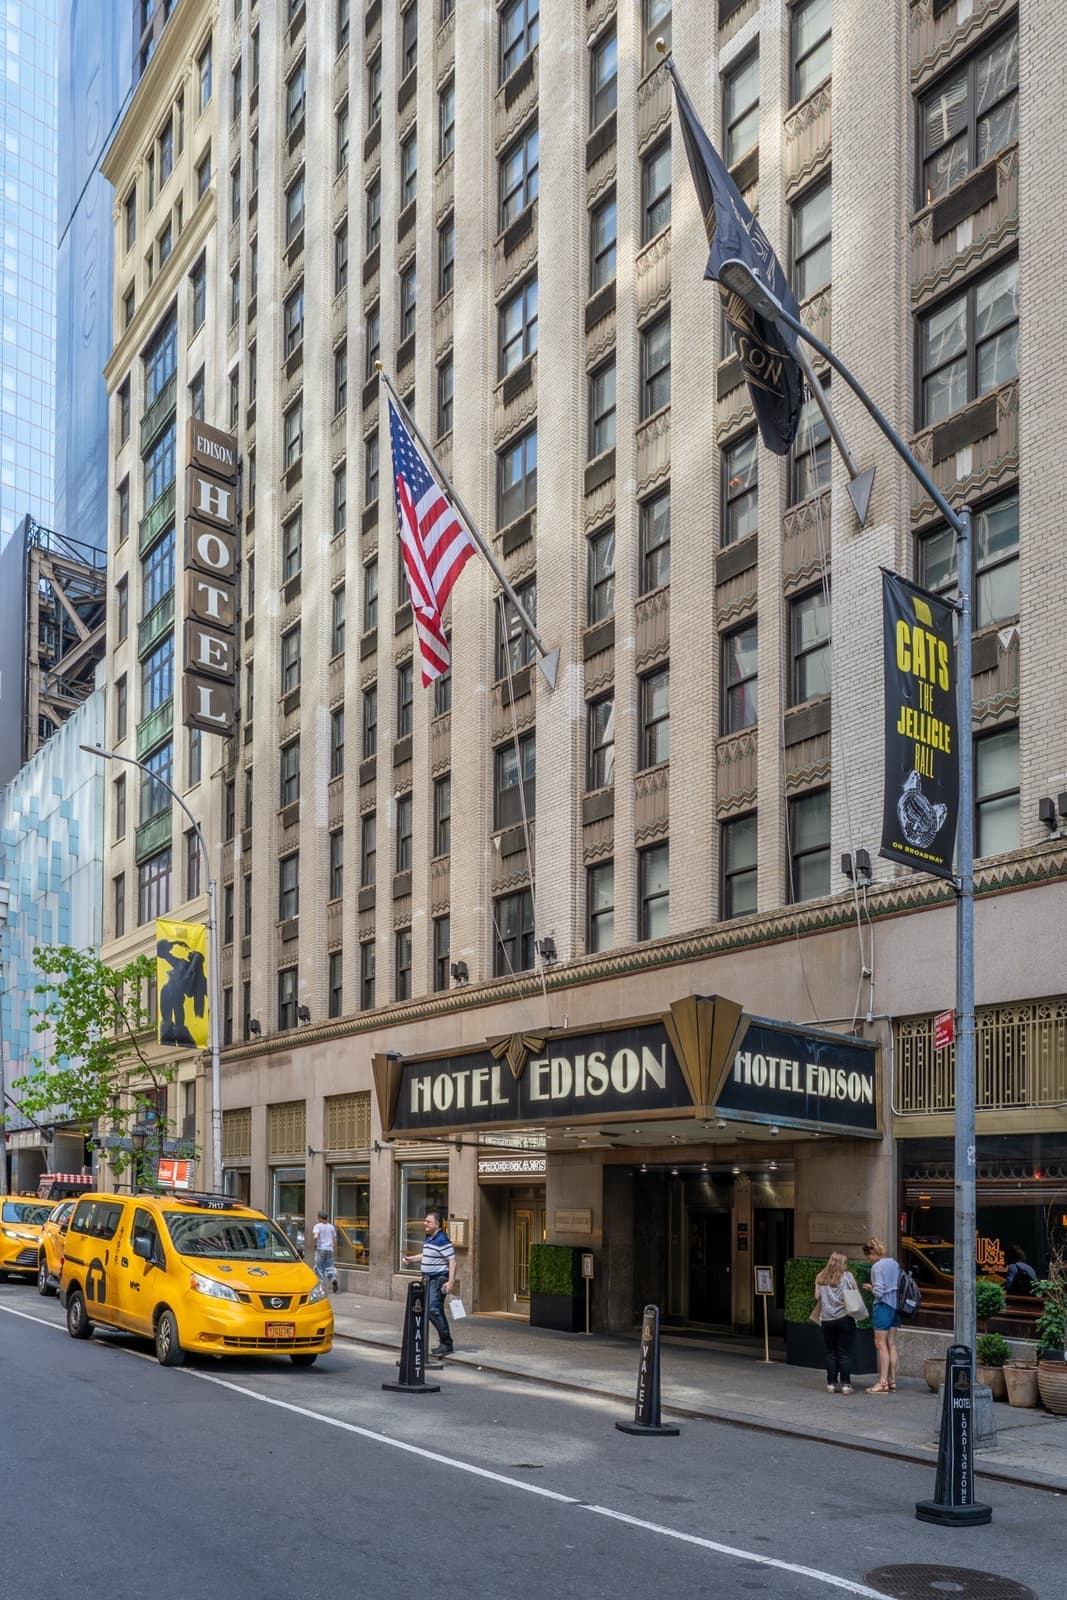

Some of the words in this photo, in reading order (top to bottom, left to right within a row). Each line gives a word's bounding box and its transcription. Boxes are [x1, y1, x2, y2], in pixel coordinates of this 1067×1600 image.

[196, 435, 233, 466] EDISON
[197, 478, 231, 722] HOTEL
[896, 620, 949, 692] CATS
[918, 680, 934, 715] THE
[897, 706, 951, 754] JELLICLE
[914, 742, 935, 779] BALL
[892, 841, 903, 850] ON
[904, 846, 944, 864] BROADWAY
[410, 1066, 509, 1113] HOTEL
[530, 1043, 667, 1101] EDISON
[733, 1050, 804, 1093] HOTEL
[806, 1063, 873, 1105] EDISON
[207, 1201, 224, 1209] 7H17
[638, 1345, 649, 1417] VALET
